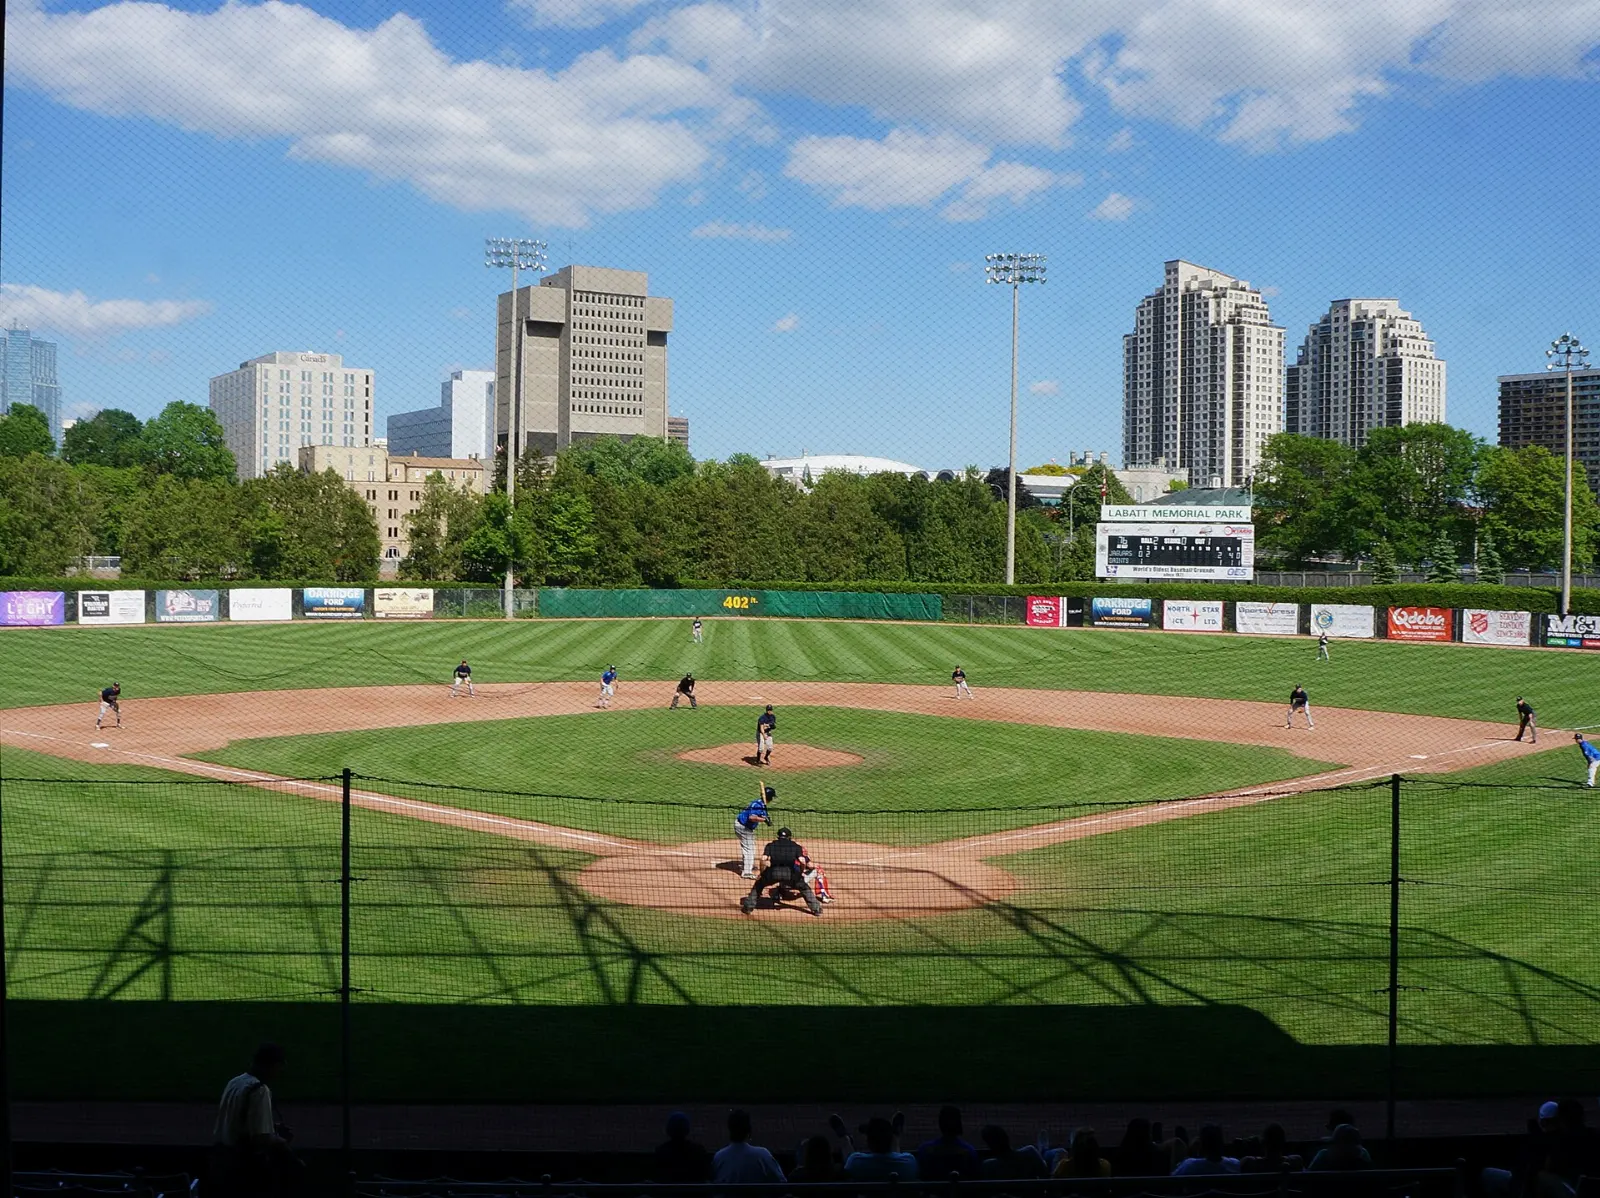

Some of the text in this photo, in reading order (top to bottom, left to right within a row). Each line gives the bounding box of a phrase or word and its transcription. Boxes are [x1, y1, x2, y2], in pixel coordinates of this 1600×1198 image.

[1108, 509, 1243, 519] LABATT MEMORIAL PARK
[308, 589, 361, 599] OAKRIDGE
[323, 598, 345, 606] FORD
[723, 596, 749, 609] 402
[1098, 598, 1149, 609] OAKRIDGE
[1111, 608, 1133, 616] FORD
[1201, 606, 1220, 614] STAR
[1392, 607, 1445, 629] Qdoba
[1500, 612, 1526, 621] SERVING
[1500, 621, 1524, 630] LONDON
